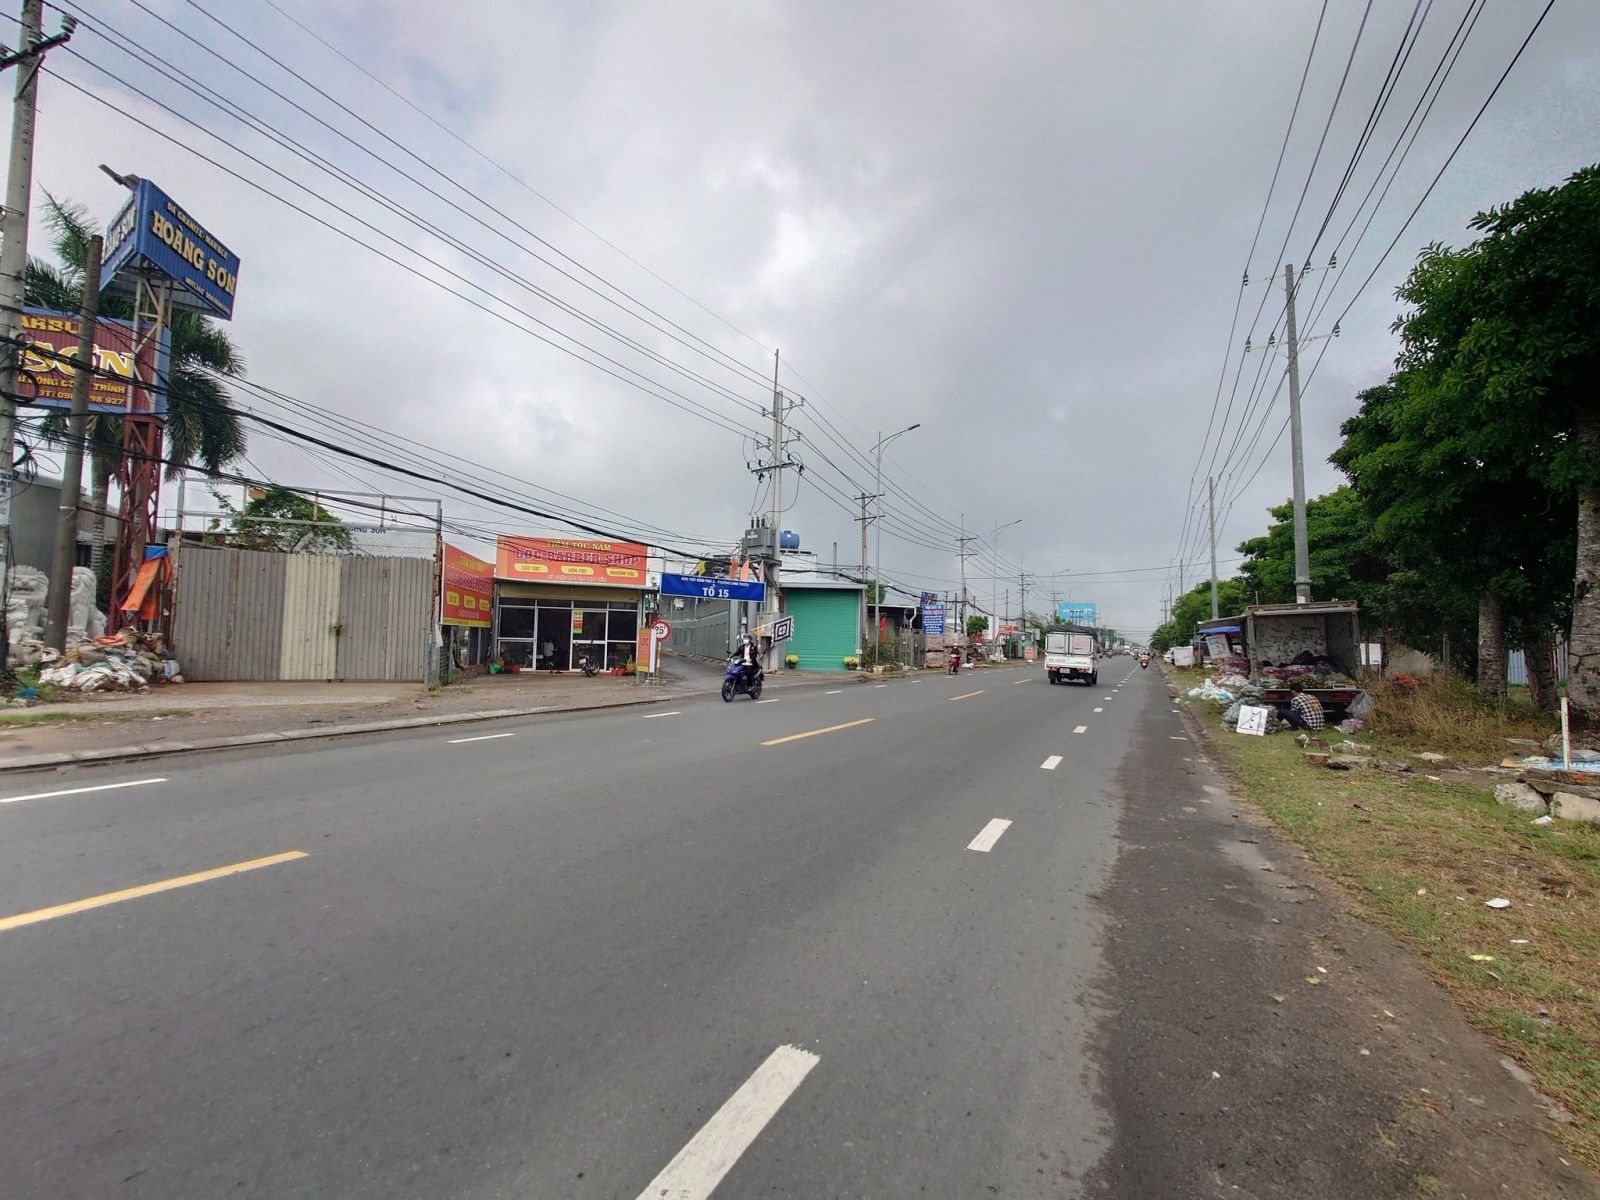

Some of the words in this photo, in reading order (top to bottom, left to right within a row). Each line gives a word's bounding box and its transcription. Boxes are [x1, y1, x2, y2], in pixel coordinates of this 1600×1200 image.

[152, 211, 204, 271] HOÀNG
[207, 258, 237, 295] SƠN
[20, 315, 79, 334] ARBL
[93, 382, 127, 393] TRÌNH
[105, 397, 124, 405] 927
[573, 541, 588, 550] TÓC
[592, 543, 611, 551] NAM
[546, 550, 600, 564] BARBER
[606, 554, 640, 566] SHOP
[702, 584, 715, 596] TỔ
[718, 589, 729, 598] 15
